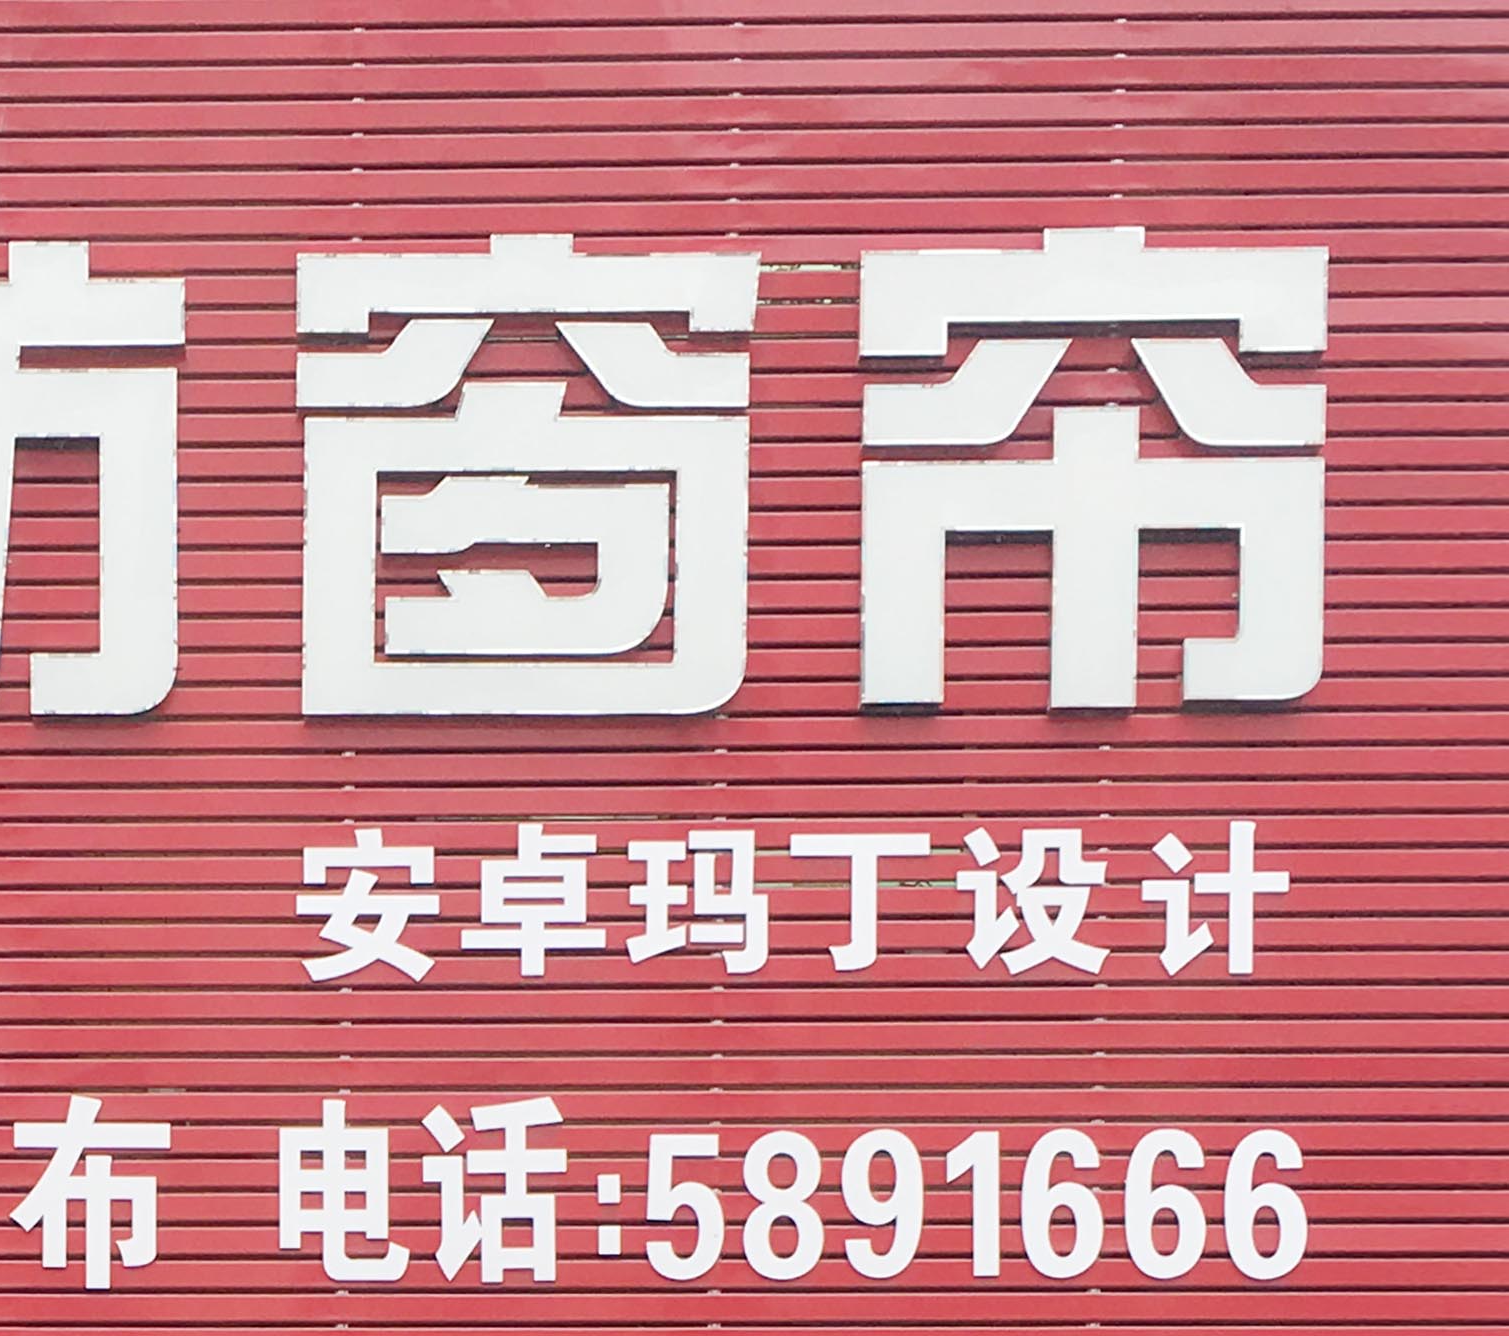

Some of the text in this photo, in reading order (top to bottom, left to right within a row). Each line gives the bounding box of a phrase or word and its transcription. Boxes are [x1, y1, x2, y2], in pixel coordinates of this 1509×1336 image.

[294, 820, 1290, 983] 安卓玛丁设计
